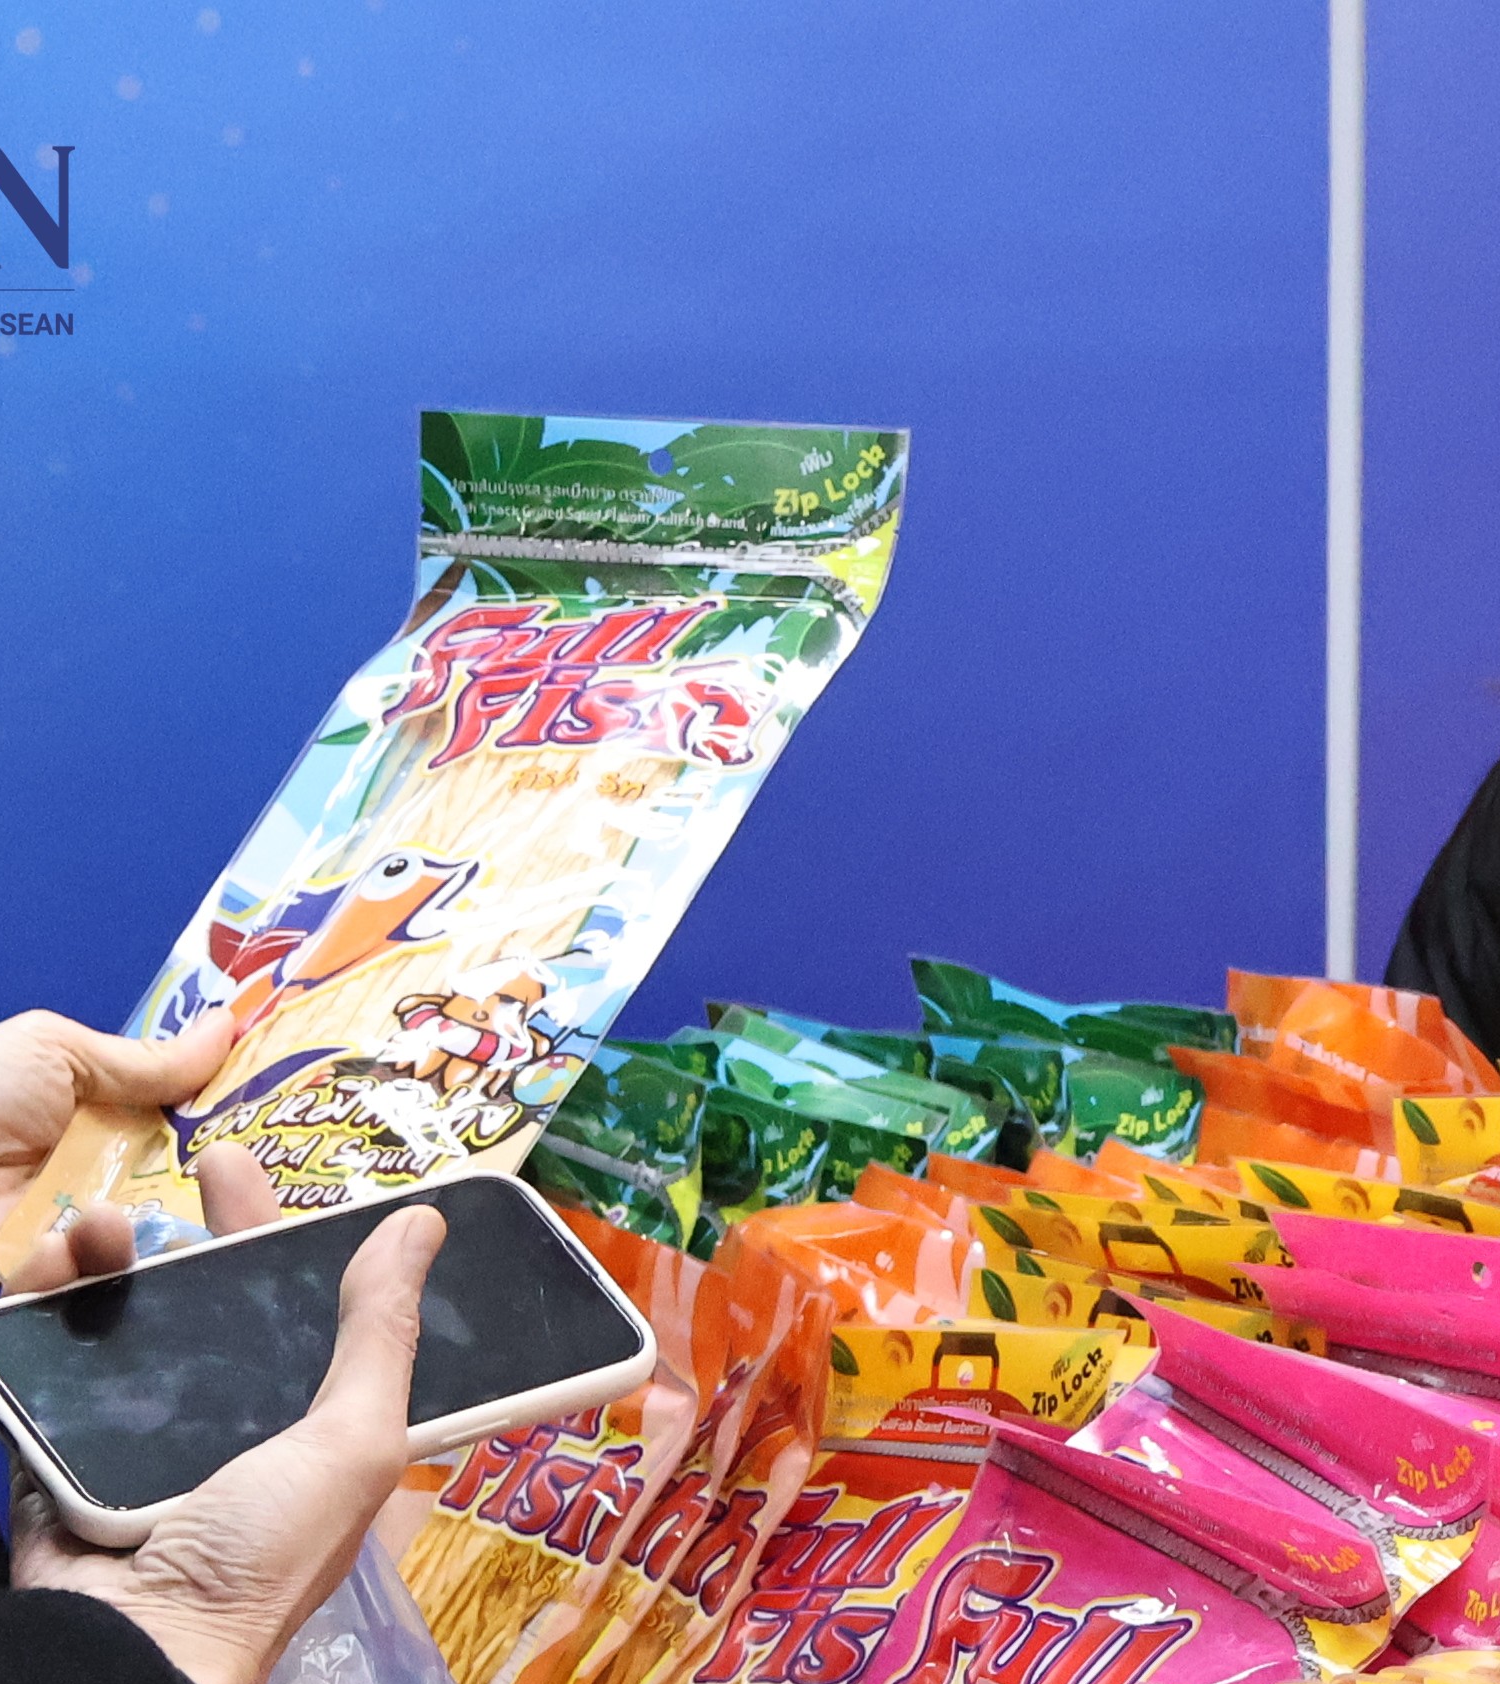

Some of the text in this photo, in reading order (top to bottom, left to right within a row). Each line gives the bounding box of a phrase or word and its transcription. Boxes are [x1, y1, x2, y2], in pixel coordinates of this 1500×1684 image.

[773, 486, 820, 519] Zip
[825, 443, 887, 508] Lock
[383, 600, 719, 727] Full
[946, 1114, 988, 1147] ock
[1115, 1089, 1194, 1138] Zip Lock
[1031, 1345, 1105, 1418] Zip Lock
[436, 1432, 646, 1567] Fish
[1395, 1445, 1476, 1494] Zip Lock
[1465, 1589, 1488, 1627] Zip
